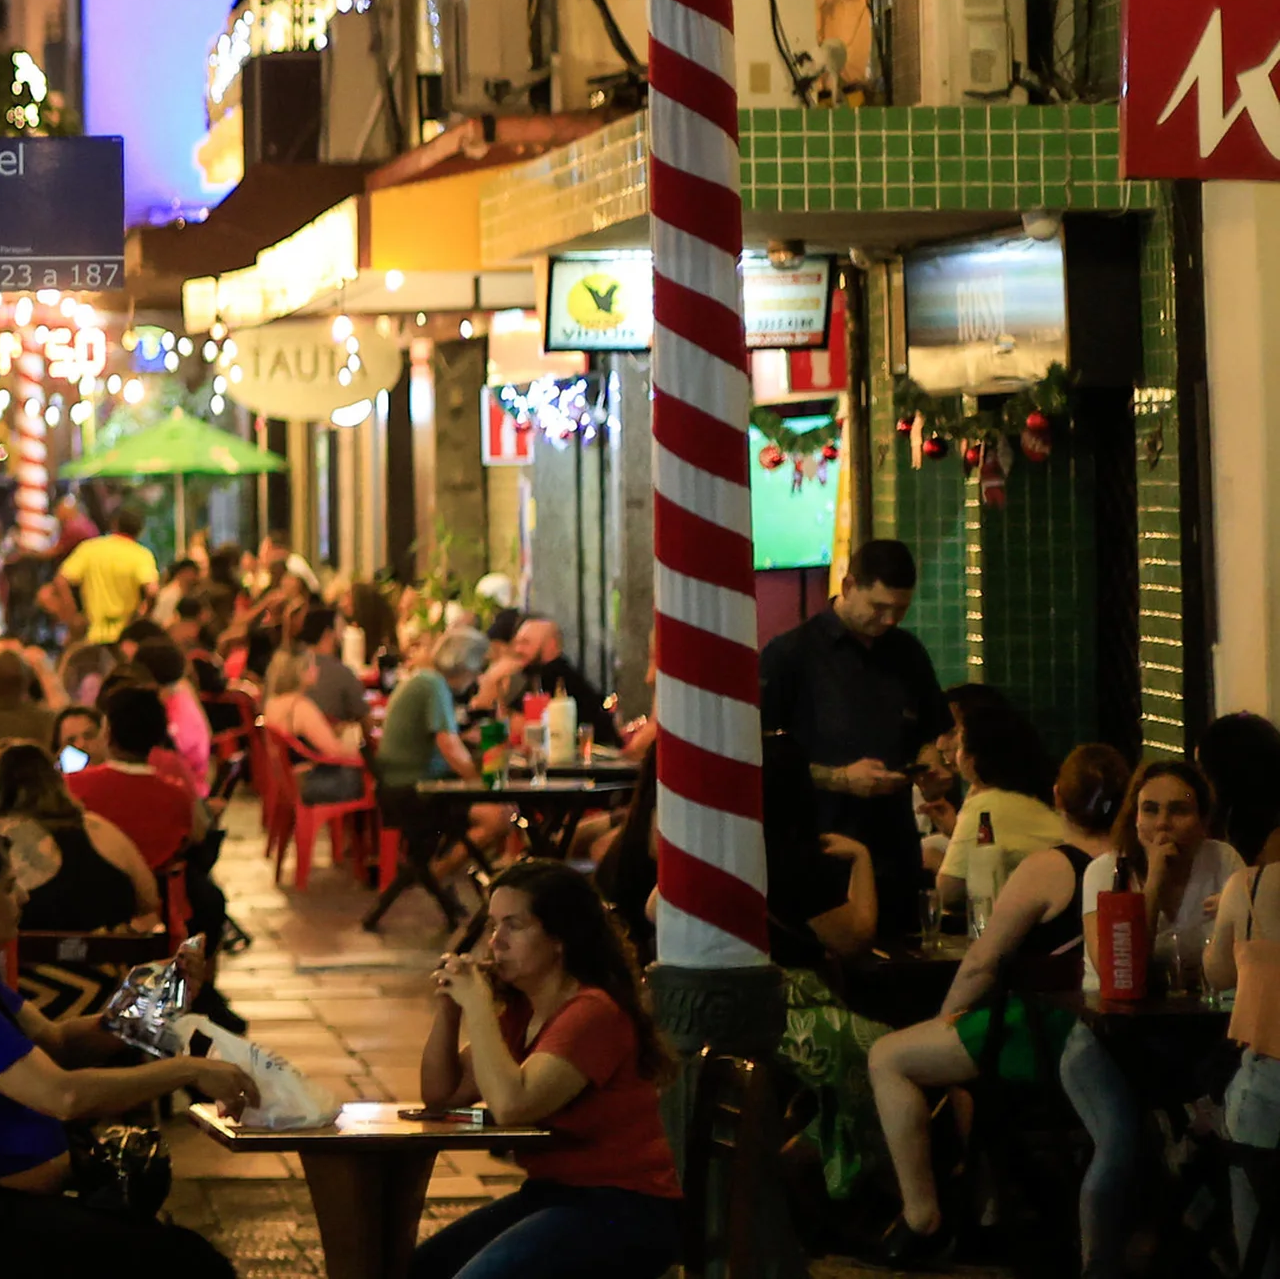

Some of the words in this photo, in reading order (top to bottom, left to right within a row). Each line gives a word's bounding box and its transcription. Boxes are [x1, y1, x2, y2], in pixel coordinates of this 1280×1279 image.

[43, 269, 58, 287] a
[71, 263, 118, 287] 187
[1112, 921, 1133, 989] BRAHMA
